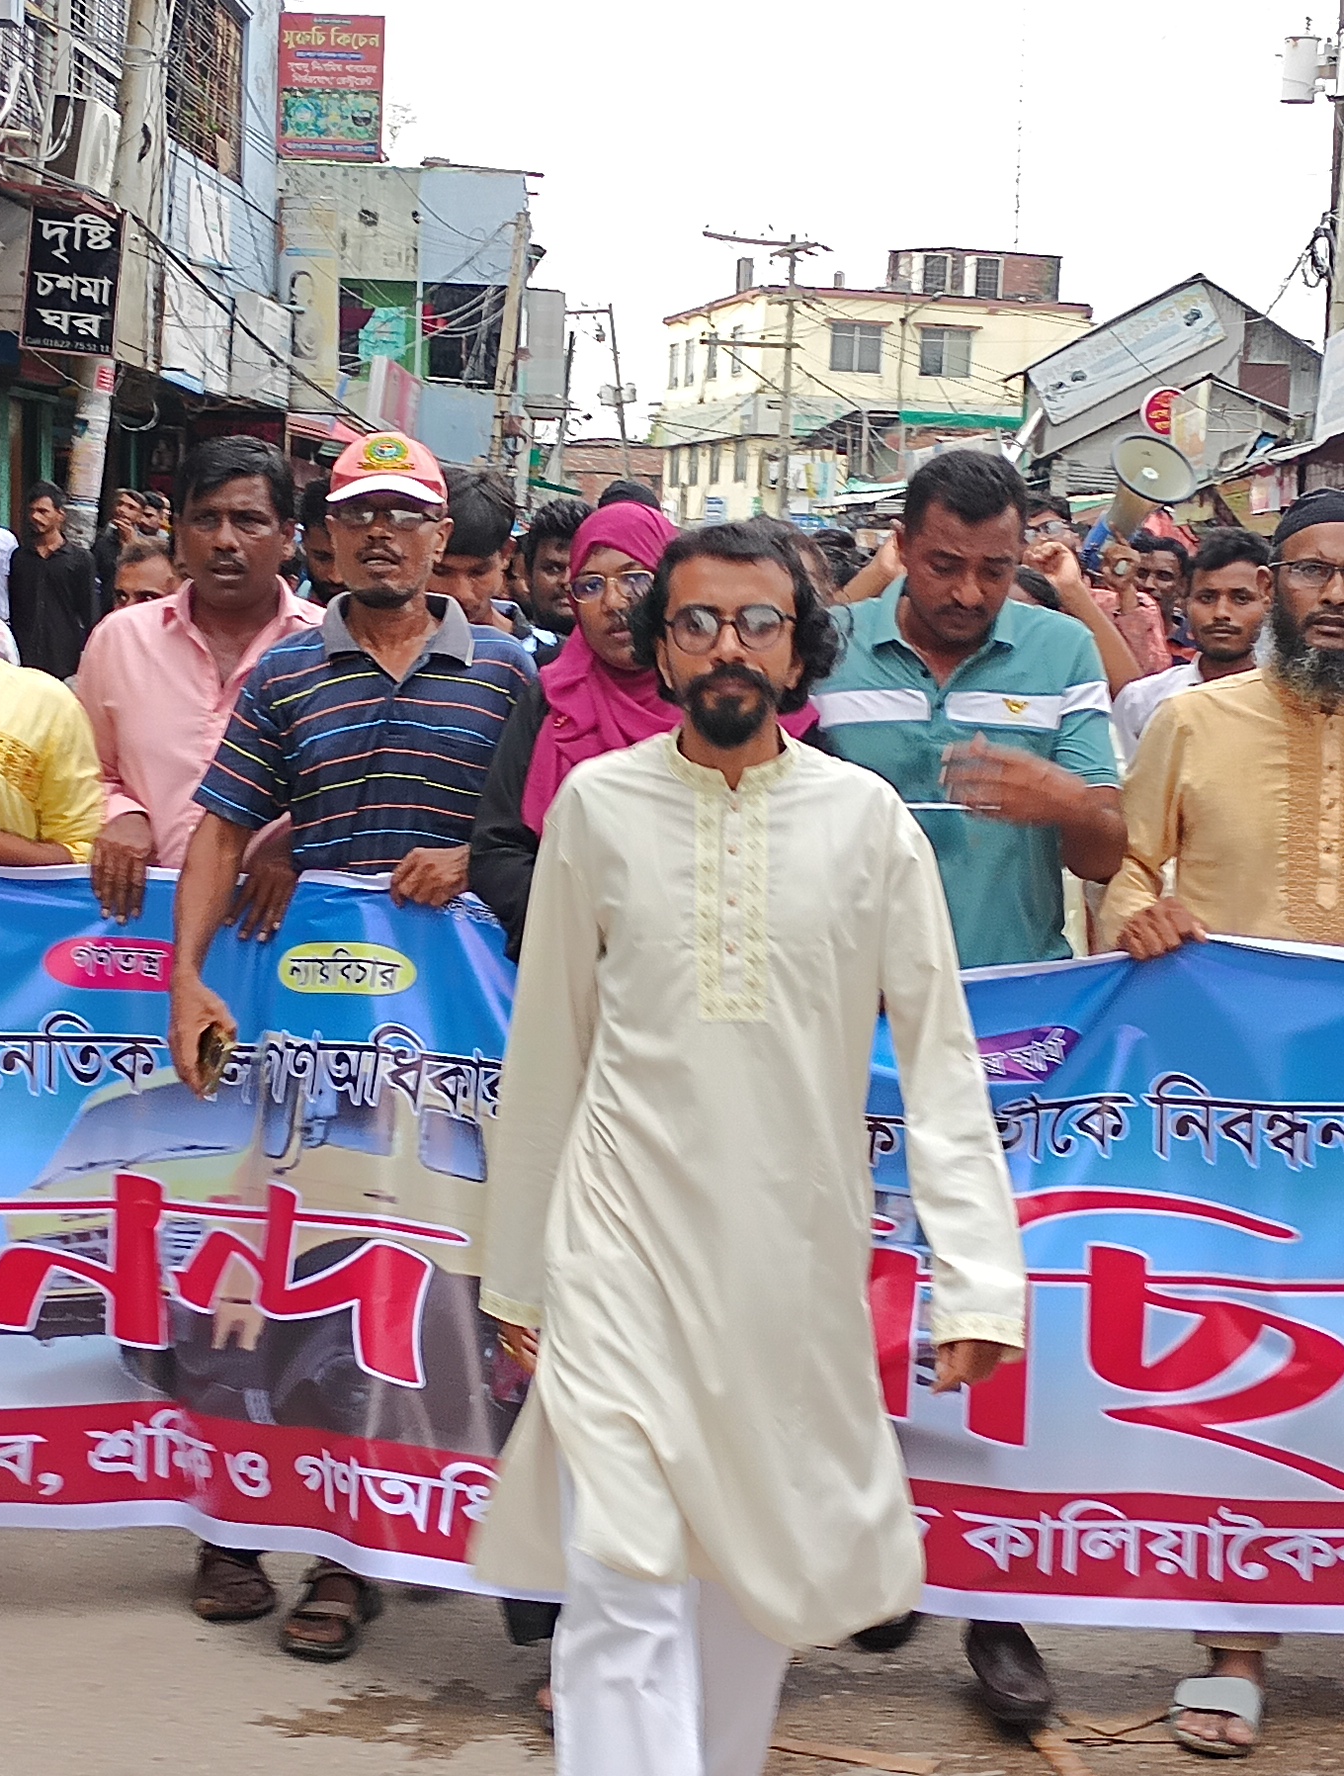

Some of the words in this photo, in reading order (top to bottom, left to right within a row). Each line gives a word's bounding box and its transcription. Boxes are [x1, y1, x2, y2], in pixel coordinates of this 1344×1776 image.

[330, 27, 379, 50] কিচেন
[37, 213, 116, 264] দৃষ্টি
[33, 271, 114, 306] চশমা
[35, 307, 104, 339] ঘর
[288, 947, 402, 988] ন্যায়বিচার
[994, 1092, 1137, 1160] তীকে
[222, 1450, 274, 1500] ও
[293, 1446, 504, 1538] গণঅধি
